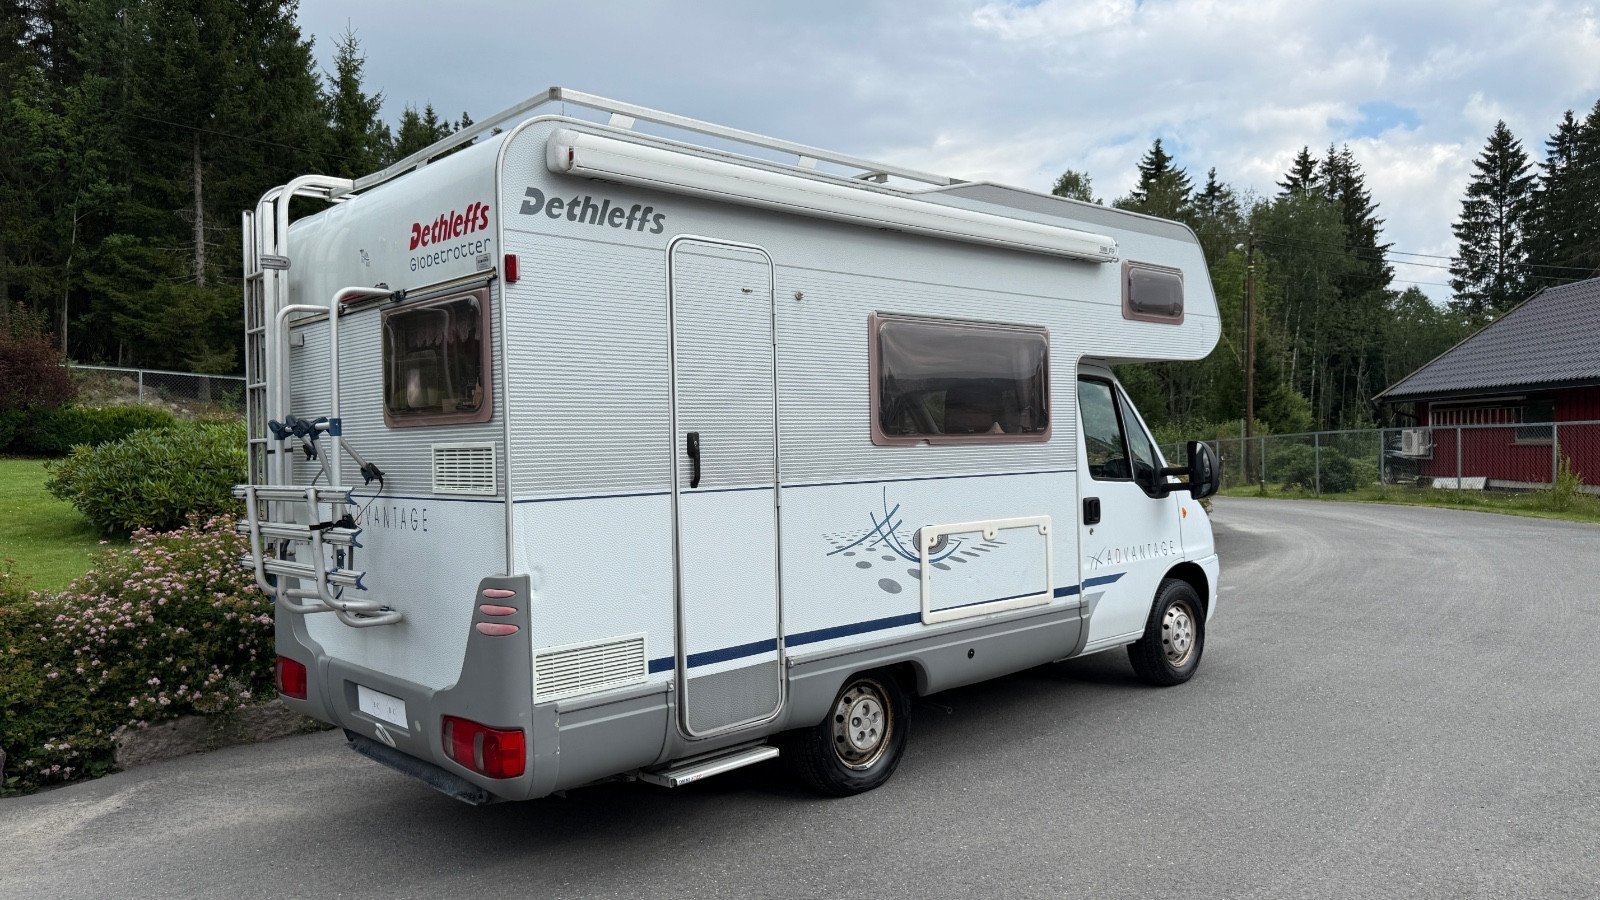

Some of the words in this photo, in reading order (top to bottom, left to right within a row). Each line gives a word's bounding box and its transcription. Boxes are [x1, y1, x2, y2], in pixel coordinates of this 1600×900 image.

[409, 201, 490, 251] Dethleffs
[519, 186, 666, 235] Dethleffs
[409, 238, 491, 272] Globetrotter
[1107, 540, 1176, 565] ADVANTAGE
